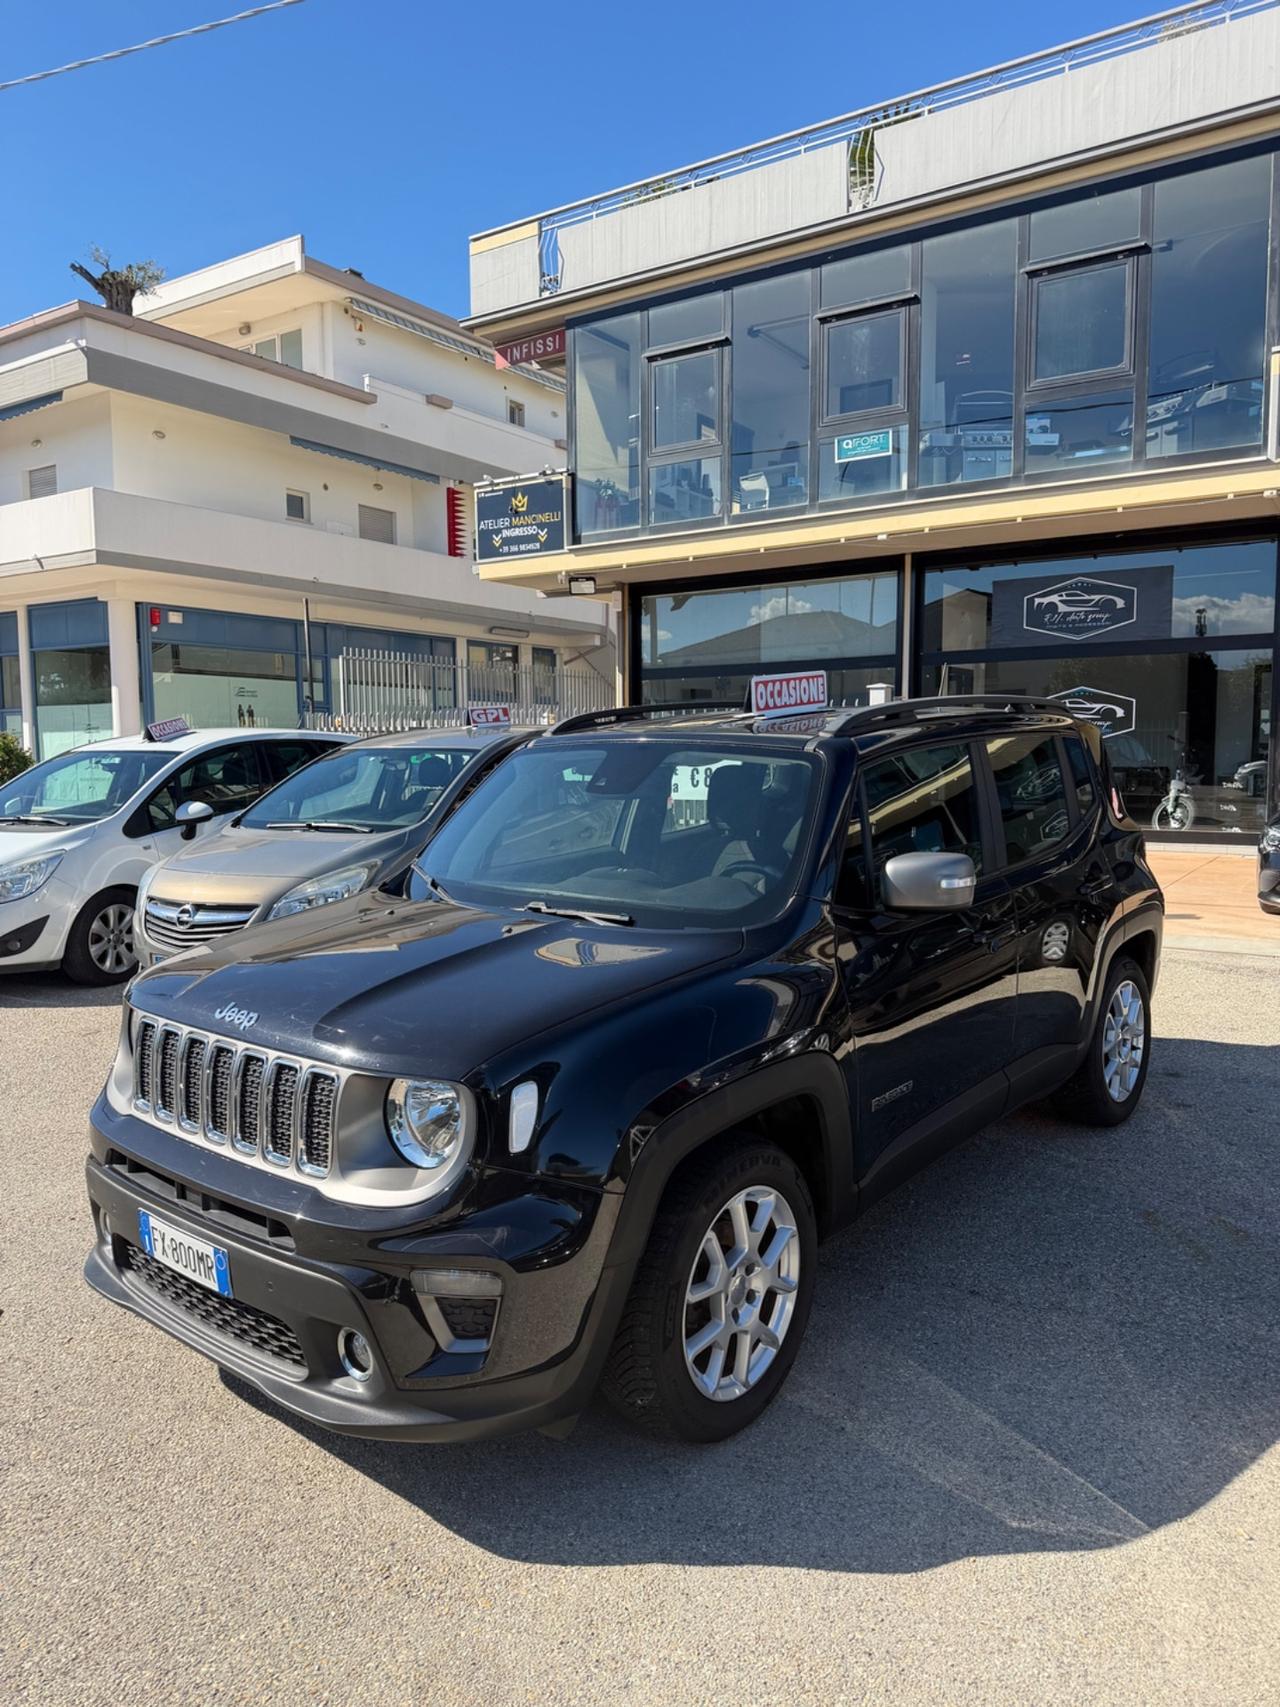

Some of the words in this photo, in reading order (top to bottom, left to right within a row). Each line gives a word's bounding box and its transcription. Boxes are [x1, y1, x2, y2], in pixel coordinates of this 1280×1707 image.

[507, 334, 559, 362] INFISSI
[479, 517, 511, 531] ATELIER
[511, 511, 562, 526] MANCINELLI
[501, 525, 538, 538] INGRESSO
[756, 677, 825, 709] OCCASIONE
[471, 708, 509, 722] GPL
[214, 1001, 259, 1031] Jeep
